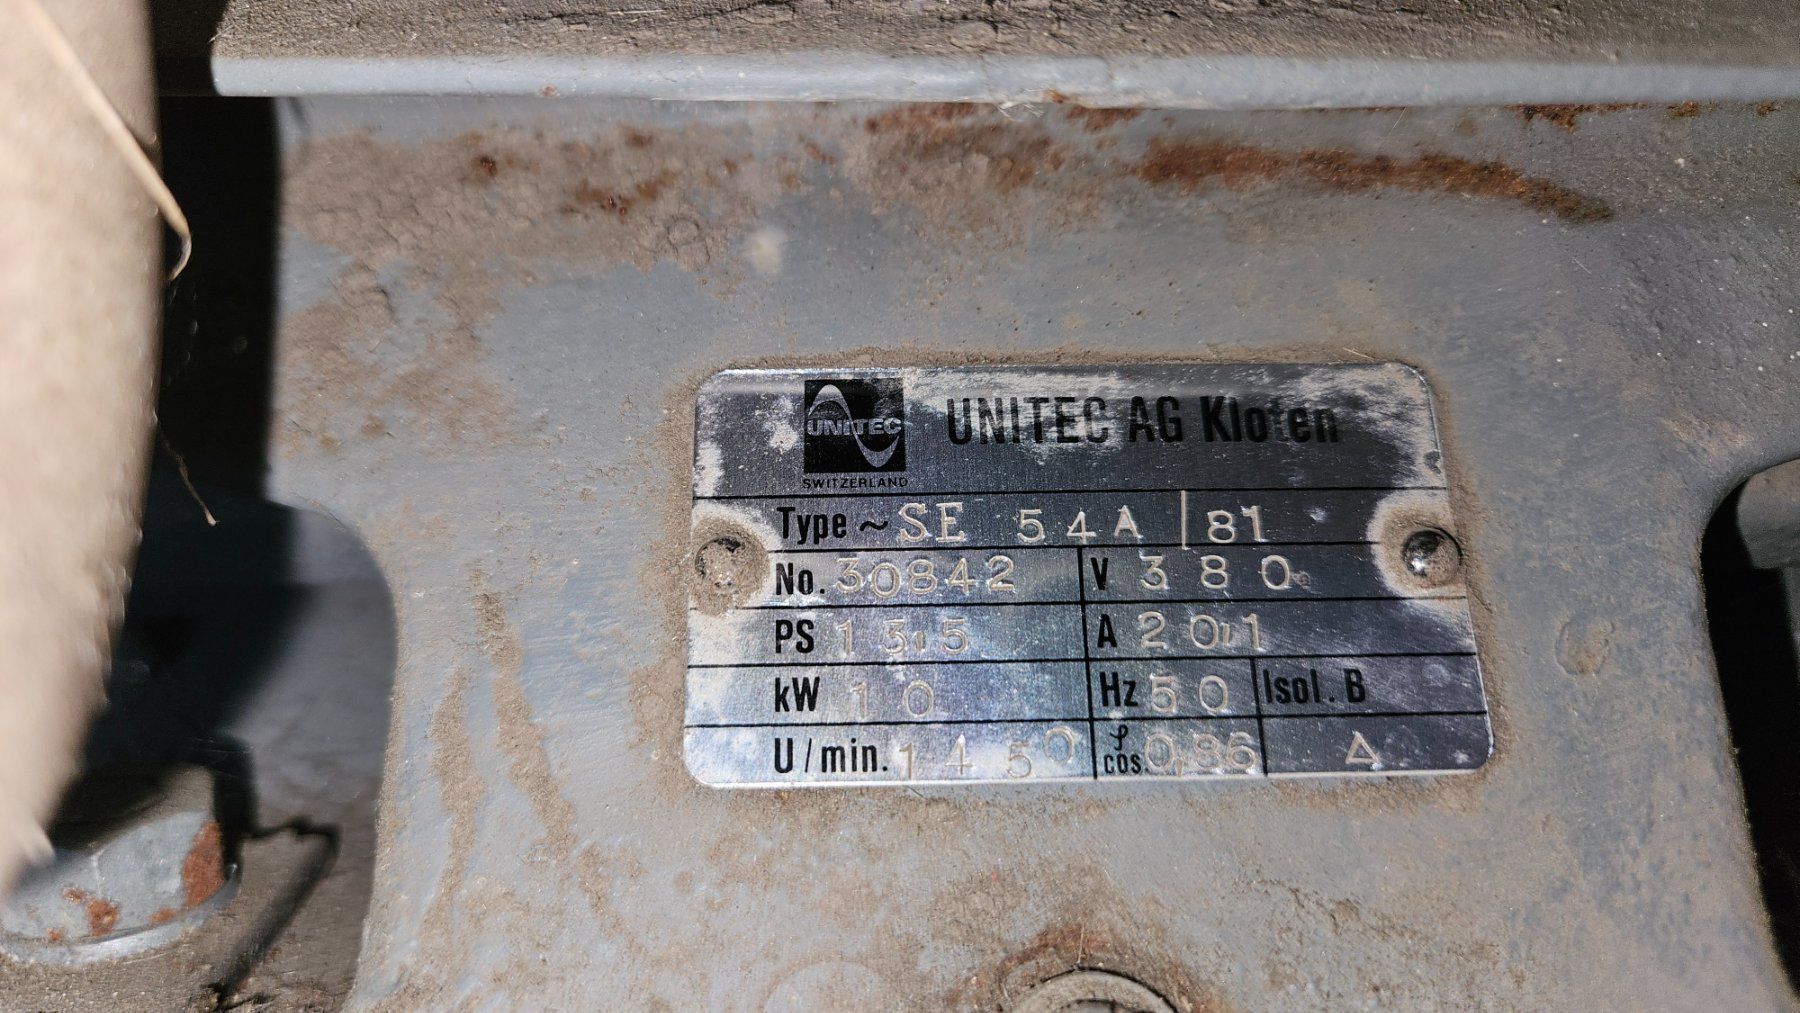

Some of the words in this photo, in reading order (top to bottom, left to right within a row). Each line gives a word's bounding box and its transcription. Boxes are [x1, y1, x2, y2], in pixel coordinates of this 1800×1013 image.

[806, 416, 903, 437] UNITEC
[946, 395, 1109, 446] UNITEC
[1128, 394, 1184, 444] AG
[1200, 394, 1339, 444] Kloten
[802, 476, 909, 490] SWITZERLAND
[777, 506, 848, 545] Type
[898, 501, 965, 543] SE
[775, 562, 826, 596] No.
[835, 554, 1016, 599] 30842
[1090, 557, 1109, 591] V
[1139, 553, 1292, 591] 380
[775, 619, 815, 654] PS
[1097, 613, 1118, 648] A
[774, 676, 820, 712] kW
[850, 679, 935, 719] 10
[1099, 671, 1139, 708] Hz
[1150, 673, 1229, 715] 50
[1263, 668, 1336, 704] Isol.
[1344, 668, 1367, 703] B
[898, 725, 1076, 781] 1450
[1143, 731, 1259, 778] 0,86
